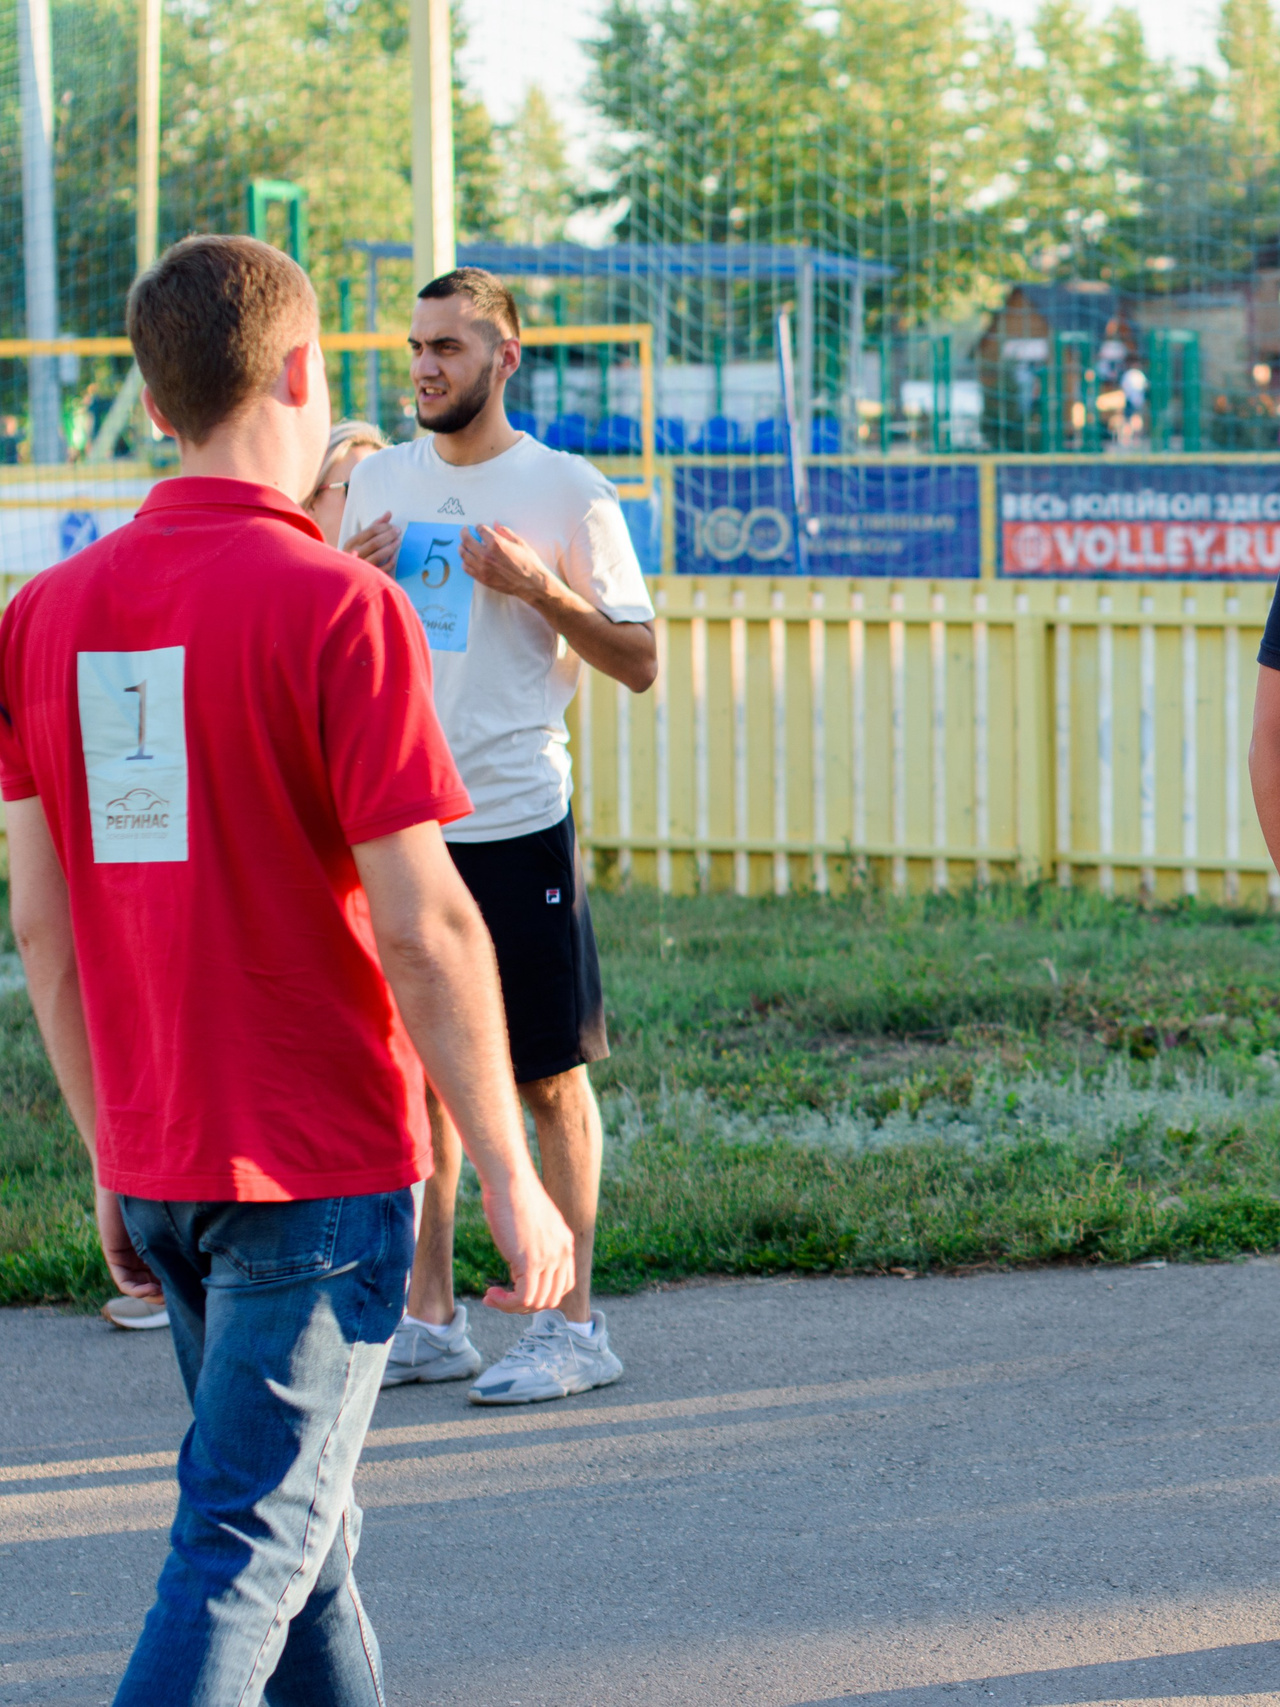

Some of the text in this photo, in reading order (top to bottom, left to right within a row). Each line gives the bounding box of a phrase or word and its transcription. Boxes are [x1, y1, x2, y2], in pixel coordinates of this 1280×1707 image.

[421, 538, 453, 589] 5
[124, 679, 154, 761] 1
[106, 813, 169, 830] РЕГИНАС
